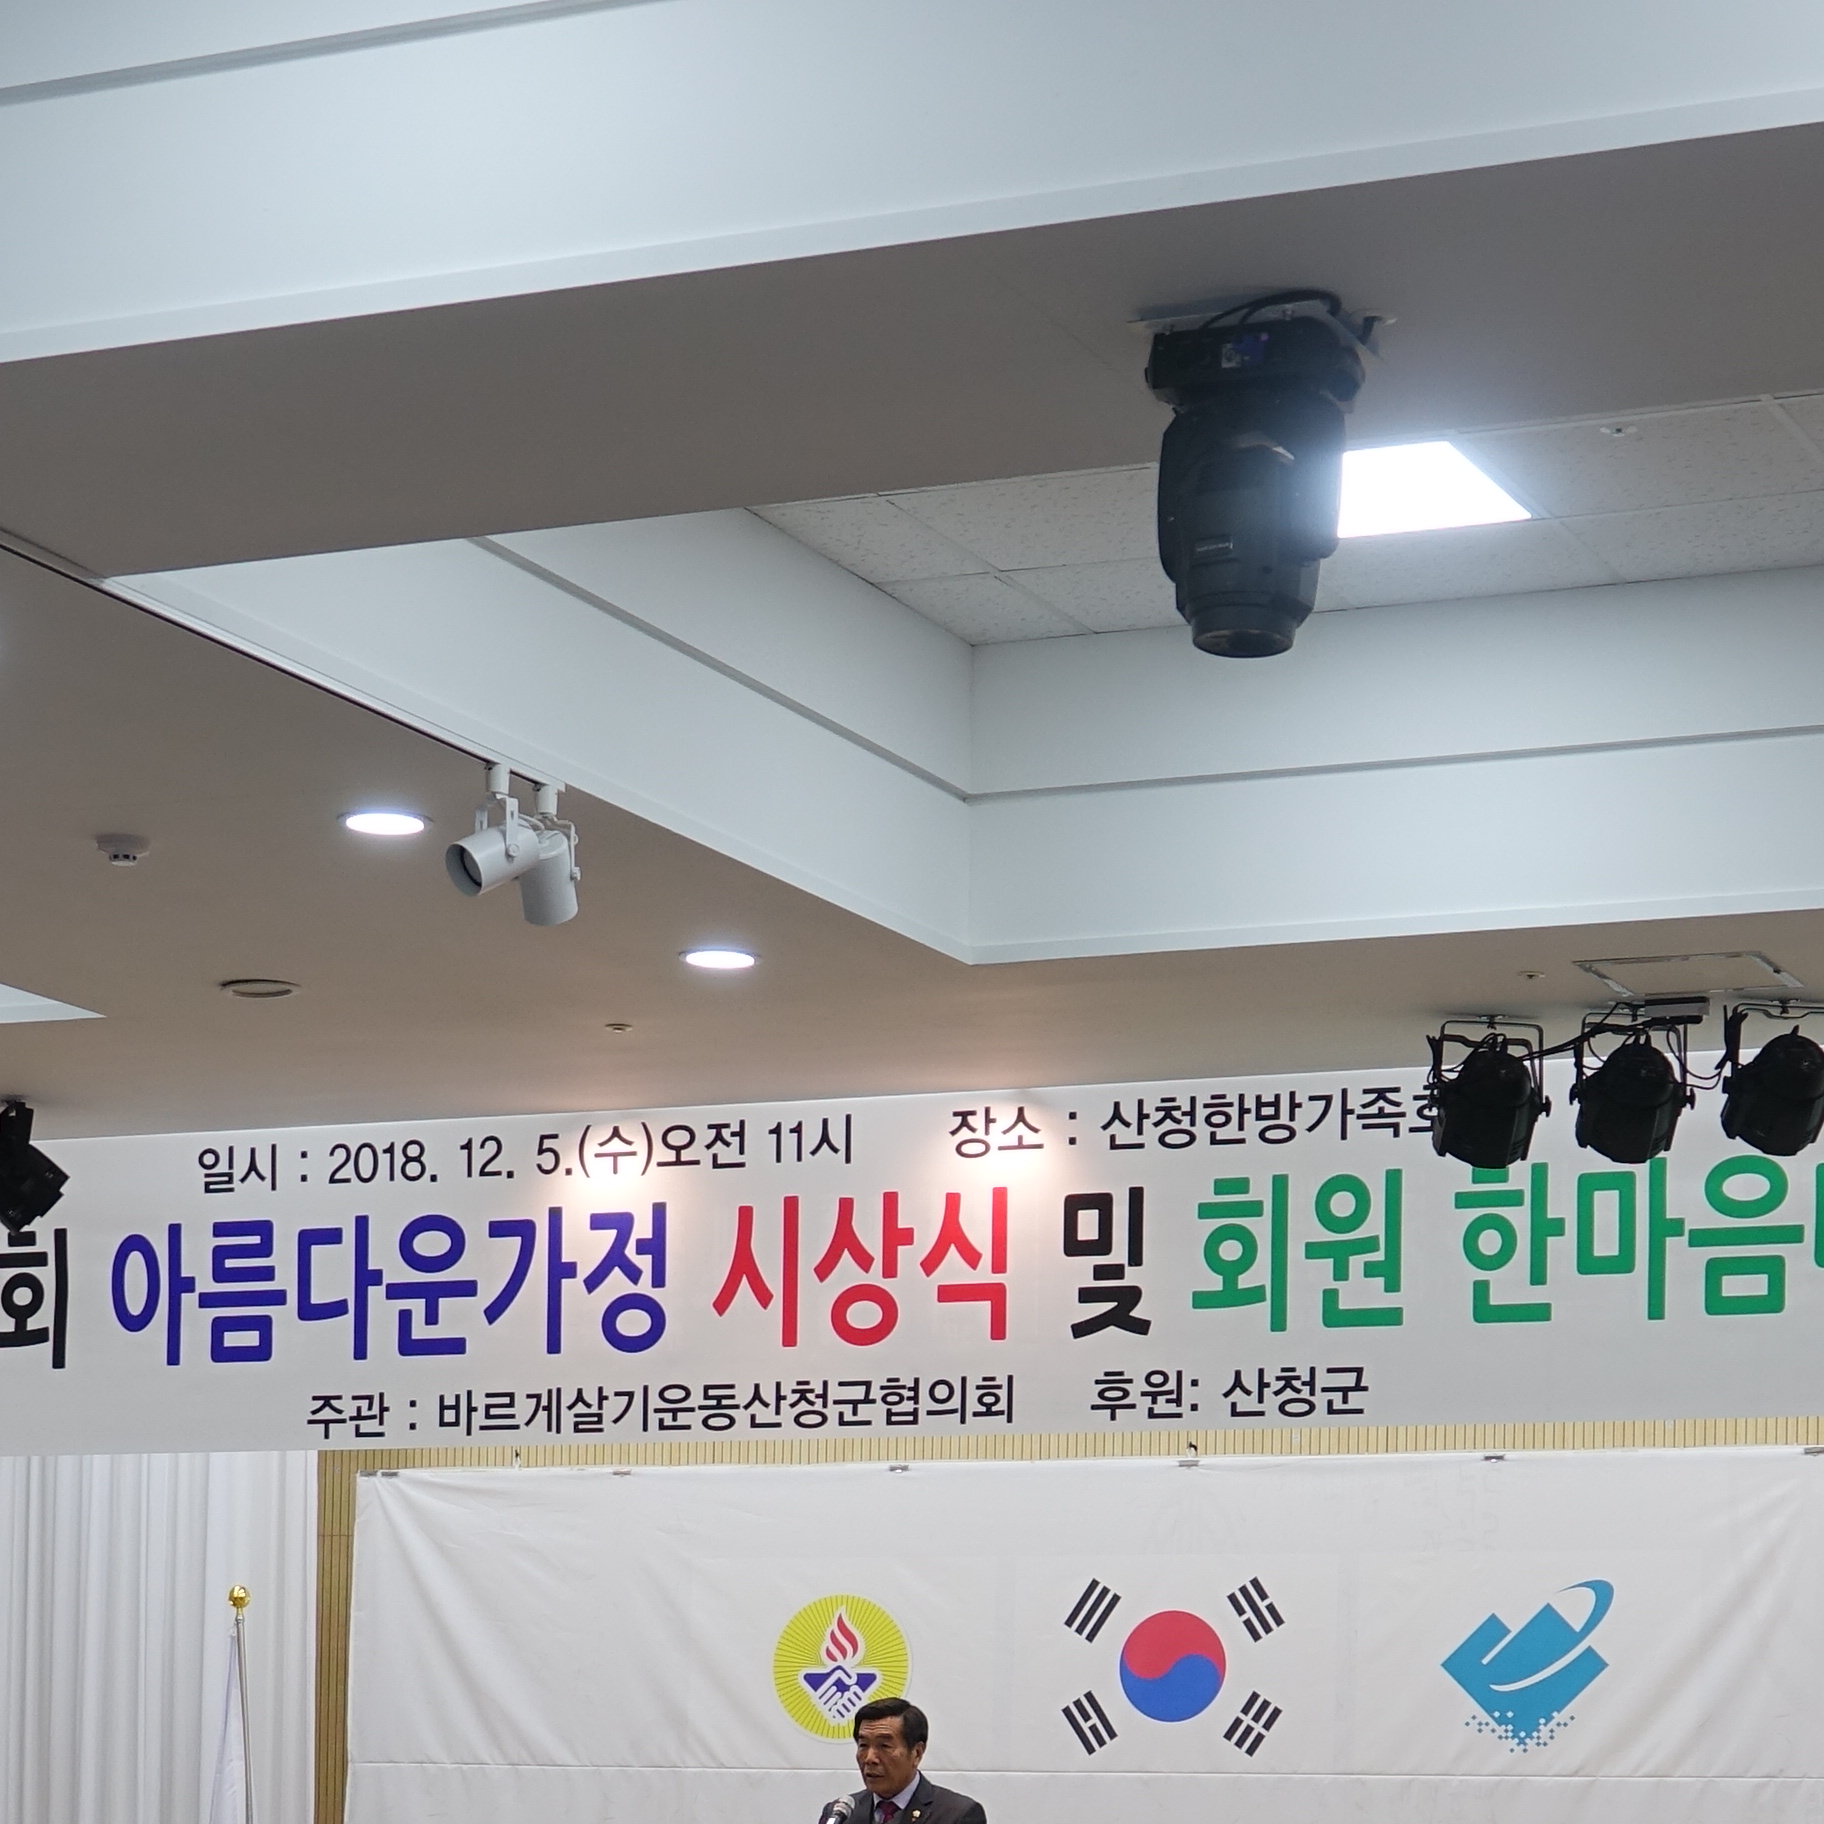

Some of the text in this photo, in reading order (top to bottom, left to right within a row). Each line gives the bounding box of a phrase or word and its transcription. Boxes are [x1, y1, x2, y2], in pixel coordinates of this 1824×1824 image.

[198, 1144, 276, 1193] 일시
[329, 1140, 437, 1184] 2018.
[460, 1136, 514, 1178] 12.
[768, 1114, 851, 1164] 11시
[949, 1105, 1042, 1158] 장소
[112, 1202, 666, 1366] 아름다운가정
[713, 1187, 1007, 1347] 시상식
[1064, 1186, 1151, 1339] 및
[1192, 1169, 1403, 1332] 회원
[307, 1392, 389, 1439] 주관
[439, 1375, 1013, 1436] 바르게살기운동산청군협의회
[1222, 1366, 1368, 1417] 산청군
